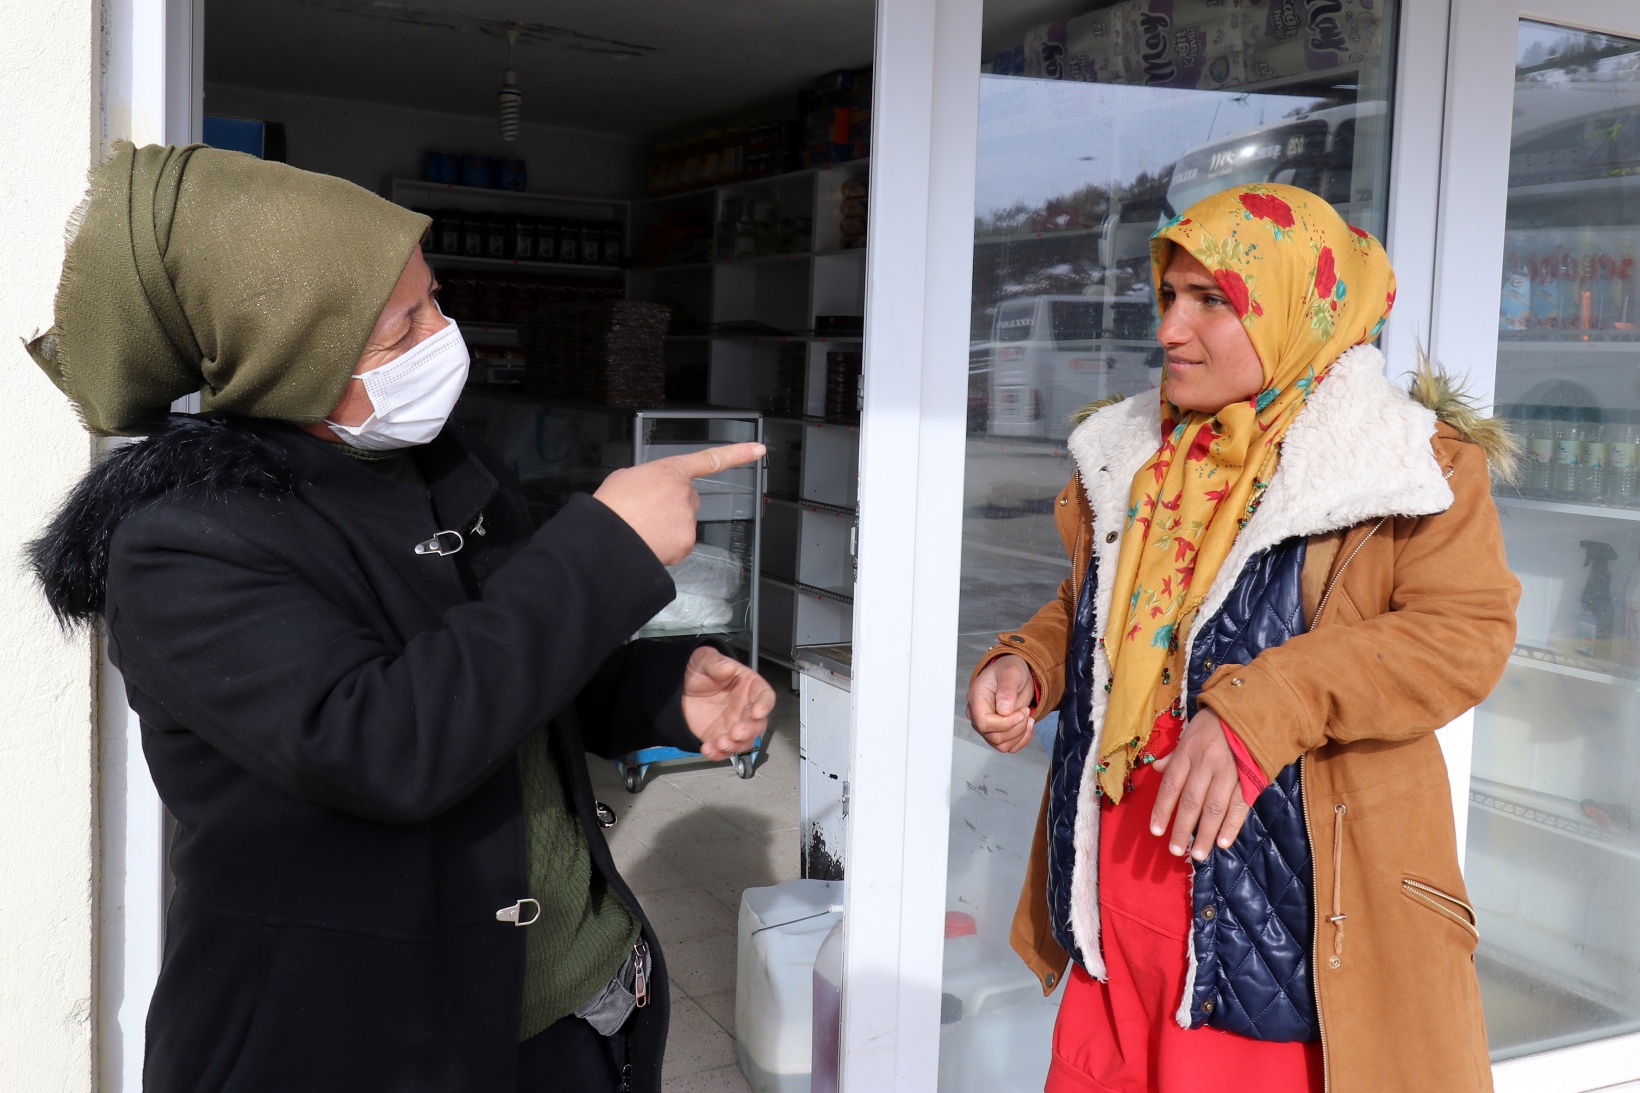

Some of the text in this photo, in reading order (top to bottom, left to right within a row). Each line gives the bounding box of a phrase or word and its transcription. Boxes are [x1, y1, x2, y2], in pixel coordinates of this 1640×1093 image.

[1093, 21, 1103, 36] 12
[1041, 42, 1064, 81] ay
[1140, 12, 1177, 85] May
[1259, 60, 1274, 77] 12
